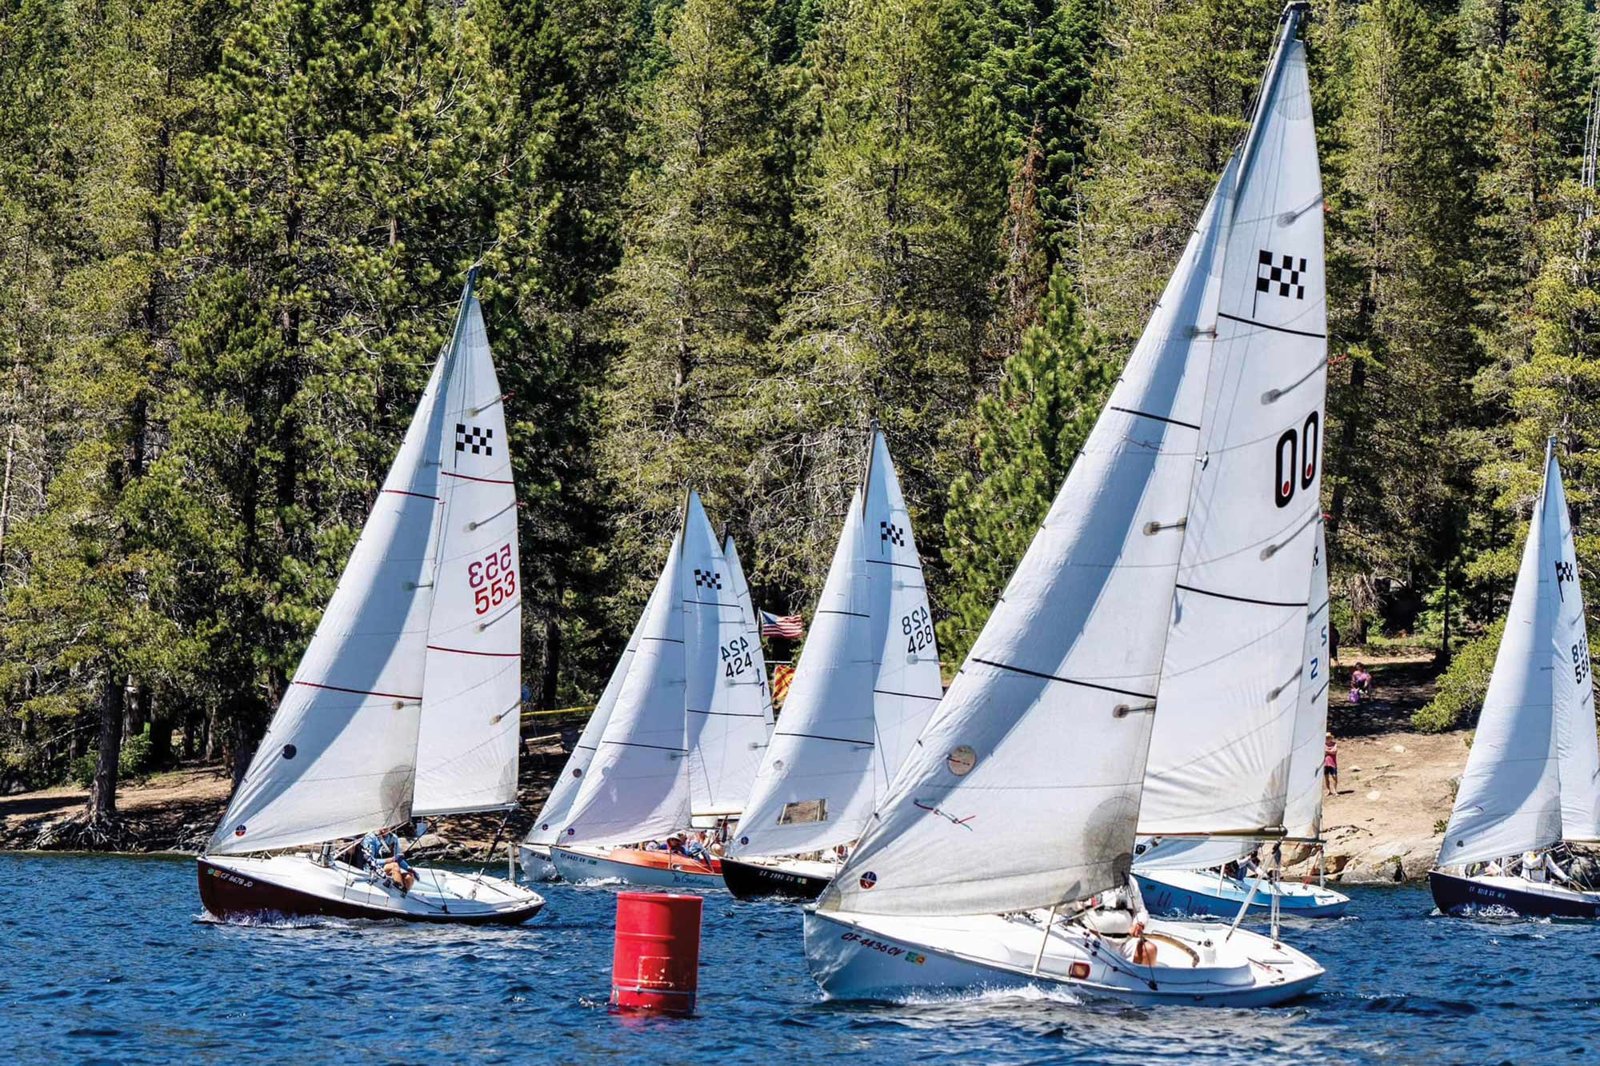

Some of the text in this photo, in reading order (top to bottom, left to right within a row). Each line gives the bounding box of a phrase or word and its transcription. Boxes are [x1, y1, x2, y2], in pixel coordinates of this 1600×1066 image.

[475, 570, 515, 615] 553
[908, 625, 933, 654] 428
[726, 651, 752, 677] 424
[841, 931, 862, 942] CF
